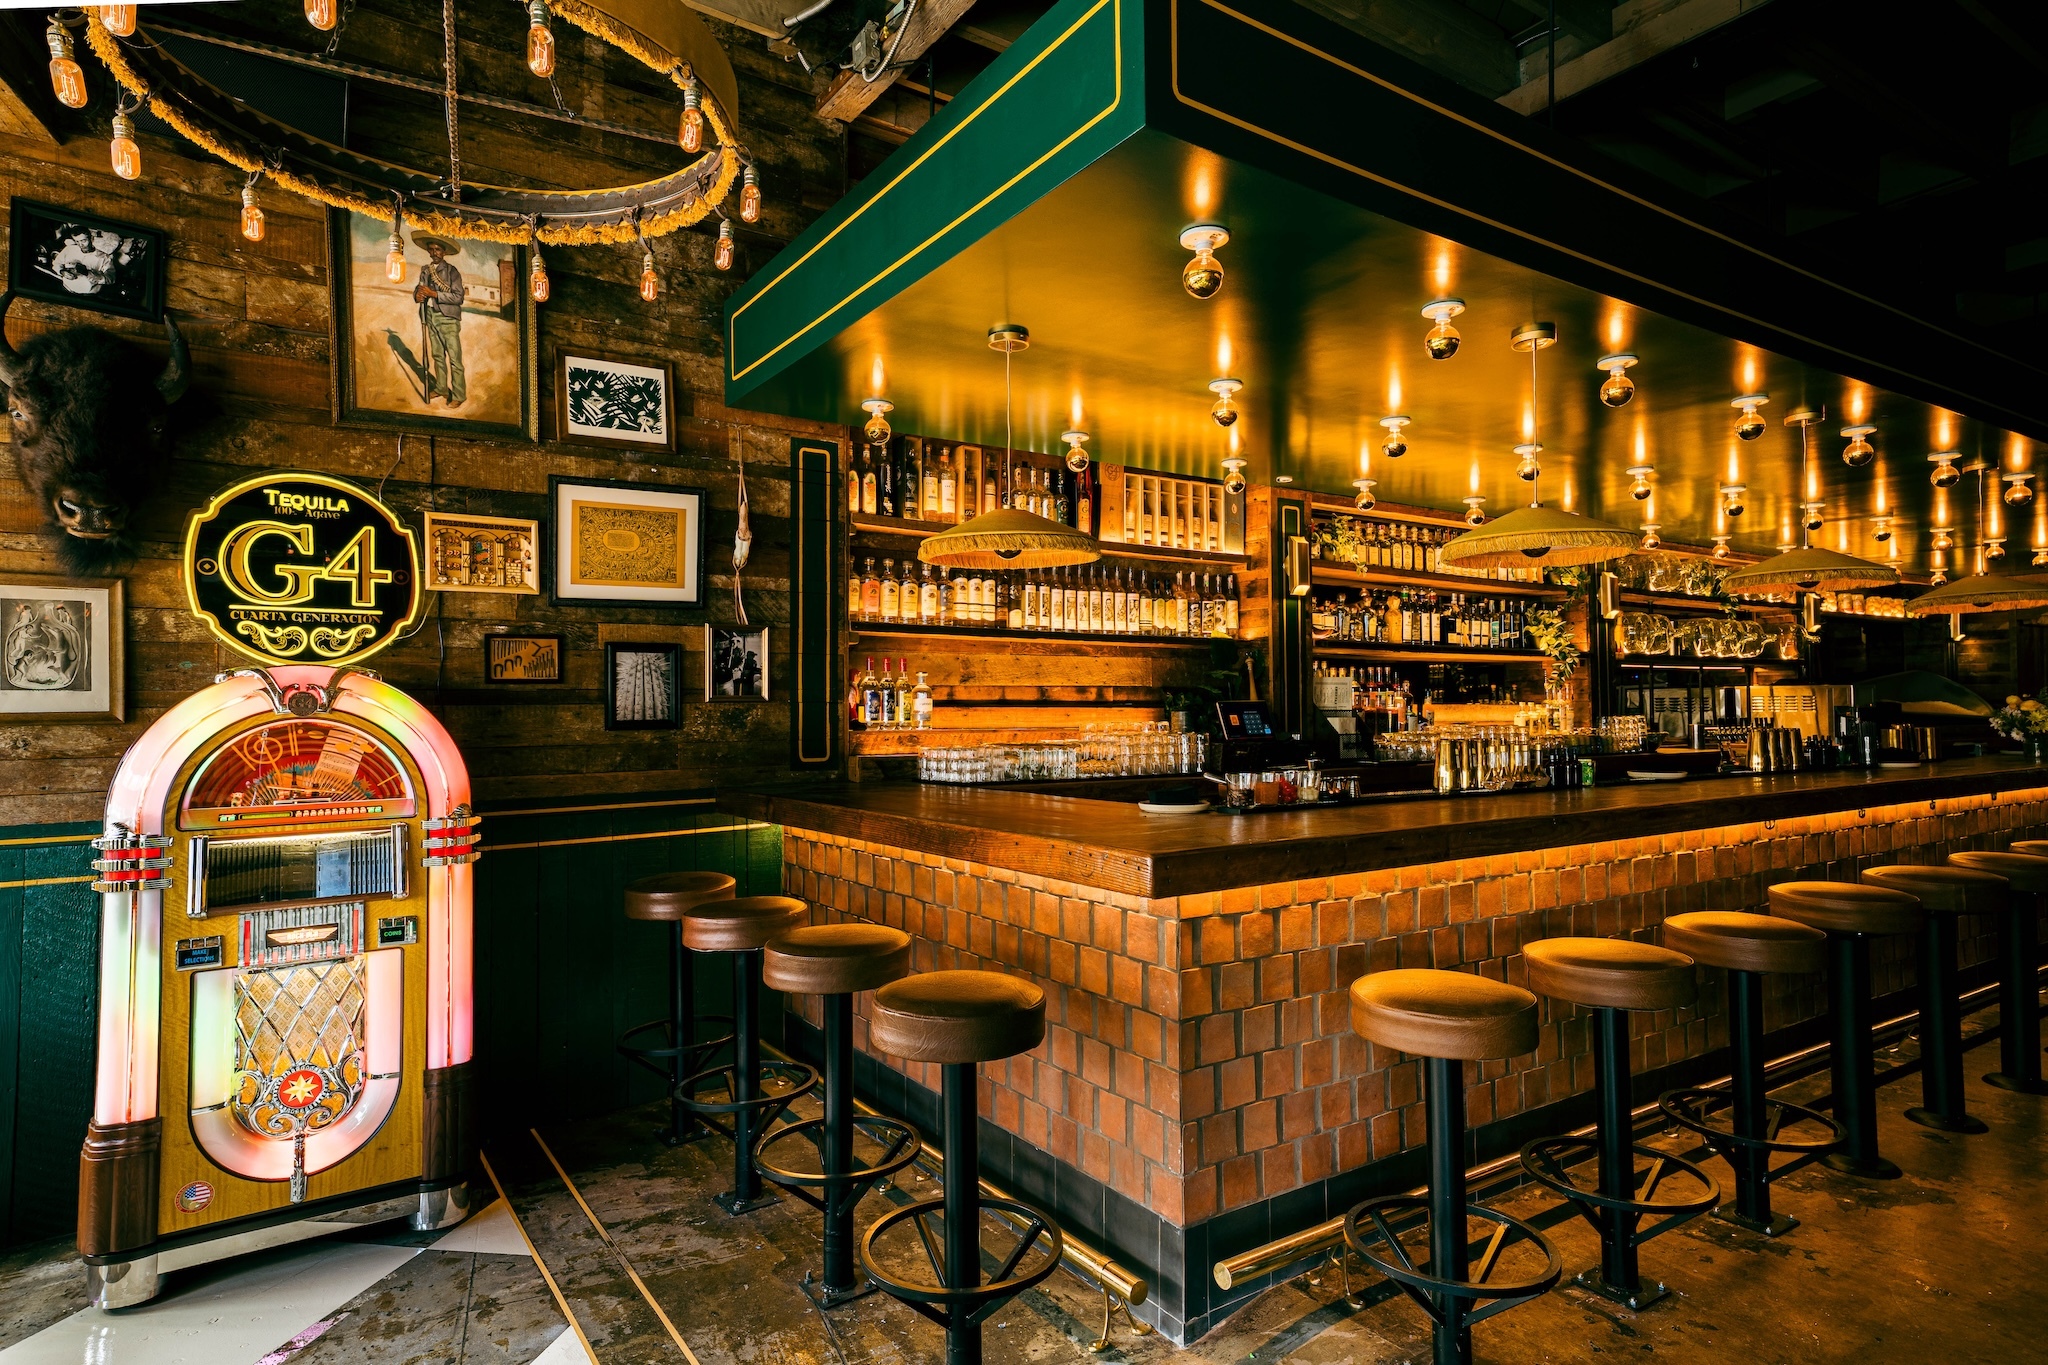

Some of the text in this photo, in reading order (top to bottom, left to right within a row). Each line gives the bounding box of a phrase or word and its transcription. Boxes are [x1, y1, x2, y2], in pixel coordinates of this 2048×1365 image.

[262, 488, 350, 513] TEQUILA
[305, 508, 341, 520] Agave
[218, 520, 392, 607] G4
[229, 610, 381, 624] CUARTA GENERACIÓN
[383, 929, 403, 937] COINS
[184, 955, 215, 965] SELECTIONS
